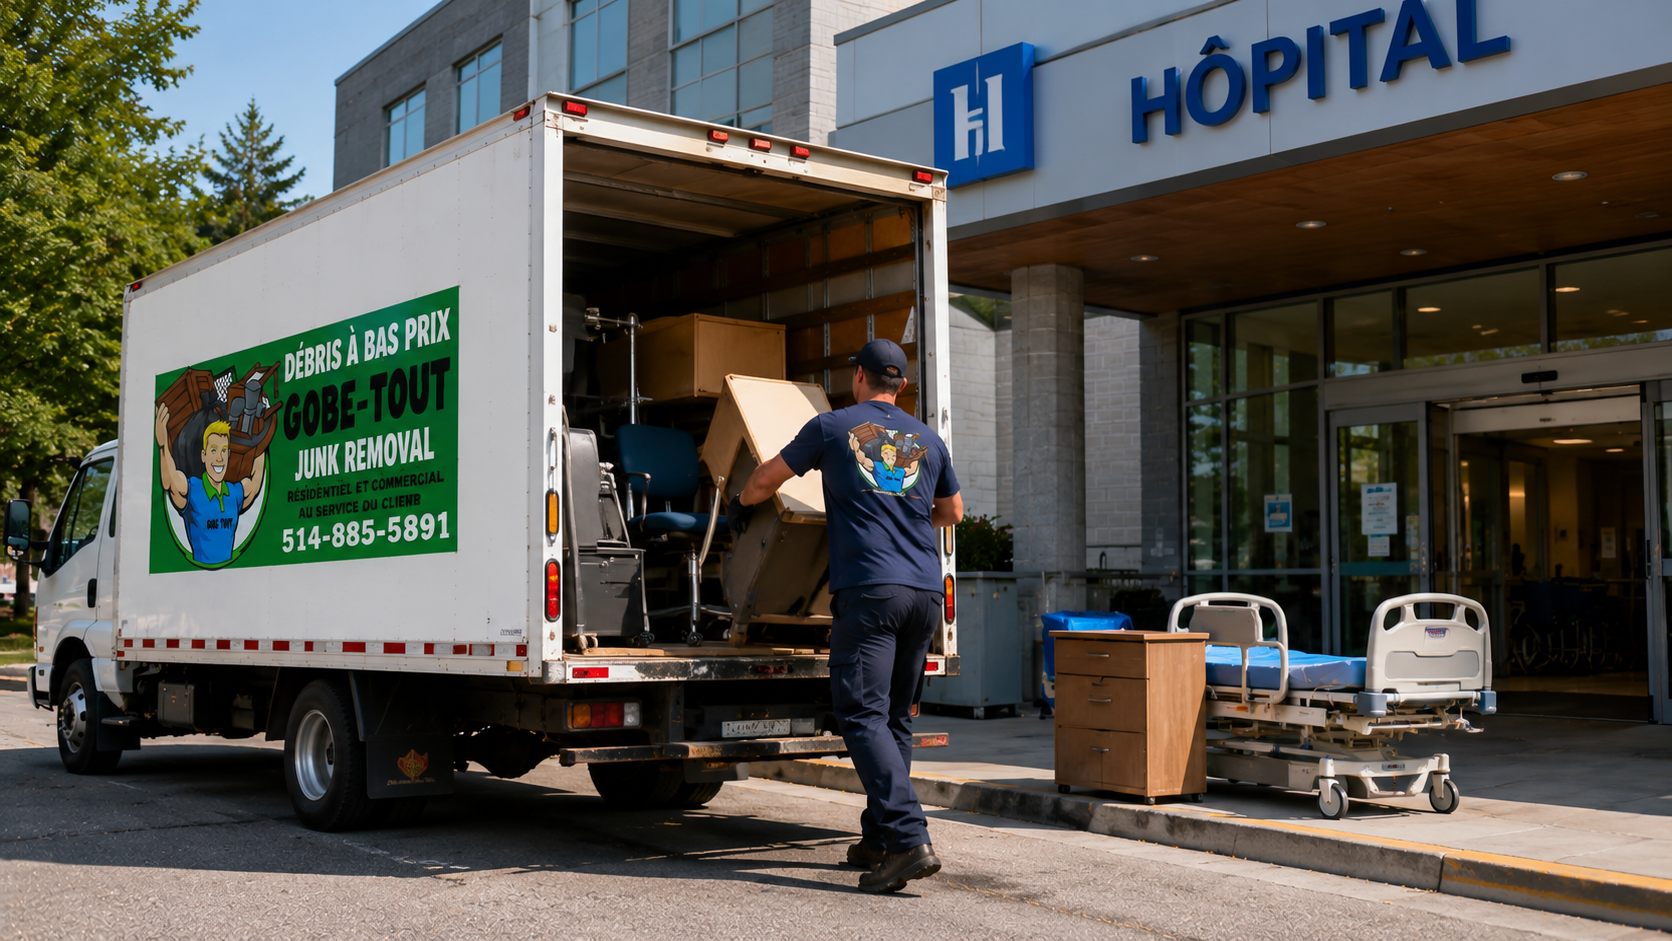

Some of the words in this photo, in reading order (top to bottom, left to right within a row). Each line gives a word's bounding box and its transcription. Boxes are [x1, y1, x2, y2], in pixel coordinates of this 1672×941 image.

[1131, 0, 1511, 144] HÔPITAL
[284, 339, 342, 383] DÉBRIS
[346, 325, 359, 366] À
[364, 322, 399, 361] BAS
[405, 307, 451, 351] PRIX
[283, 356, 451, 441] GOBE-TOUT
[294, 443, 340, 481] JUNK
[344, 426, 435, 473] REMOVAL
[298, 506, 313, 519] AU
[315, 501, 359, 517] SERVICE
[362, 499, 378, 512] DU
[355, 480, 369, 494] ET
[371, 470, 445, 491] COMMERCIAL
[282, 511, 450, 553] 514-885-5891
